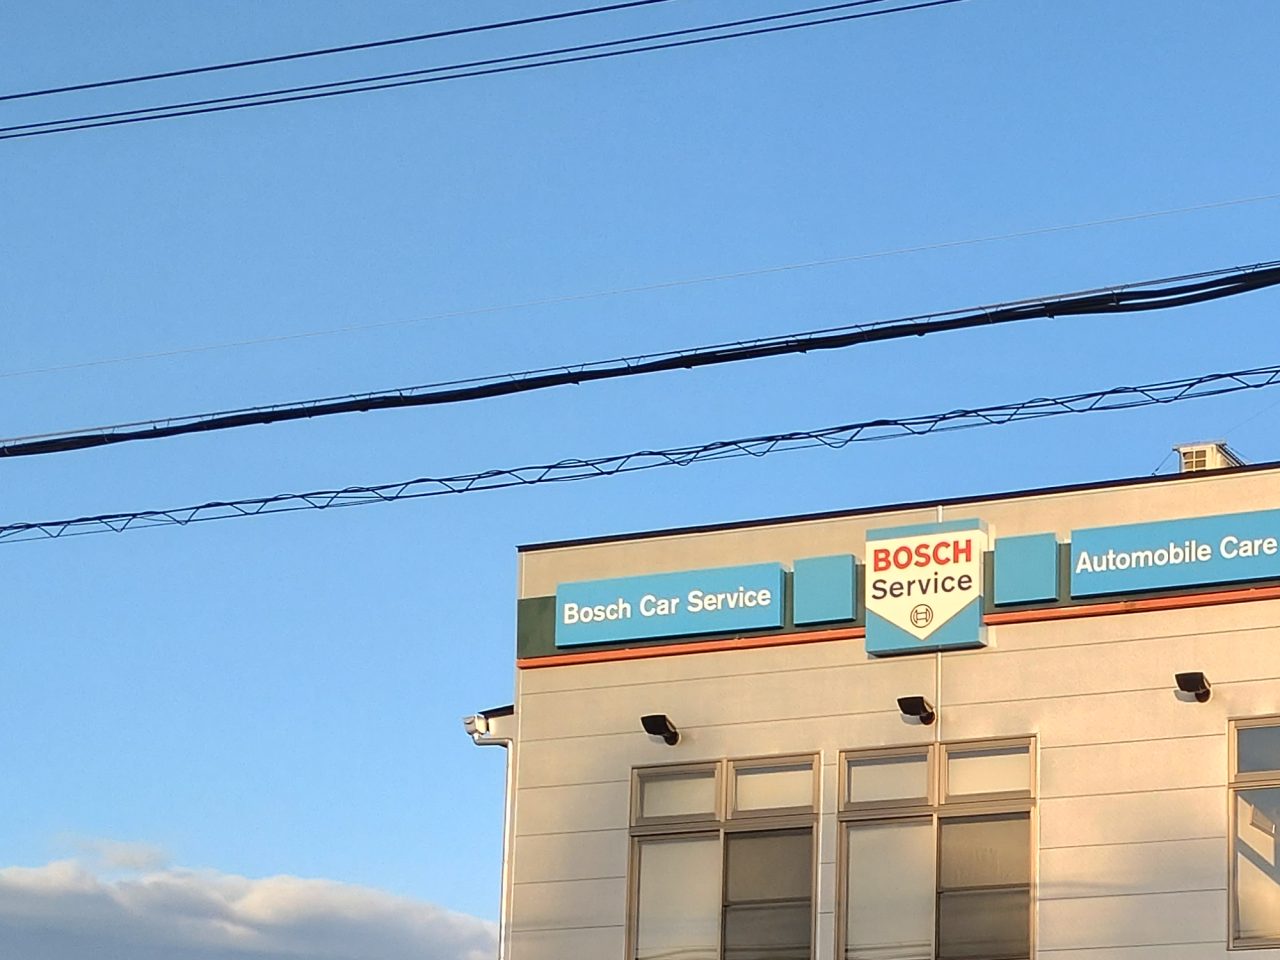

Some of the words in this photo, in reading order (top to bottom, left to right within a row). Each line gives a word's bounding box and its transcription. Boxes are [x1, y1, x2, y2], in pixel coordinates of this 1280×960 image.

[873, 538, 972, 572] BOSCH
[1075, 542, 1211, 574] Automobile
[1220, 535, 1278, 560] Care
[871, 572, 973, 600] Service
[562, 598, 631, 625] Bosch
[639, 594, 680, 617] Car
[687, 586, 771, 613] Service
